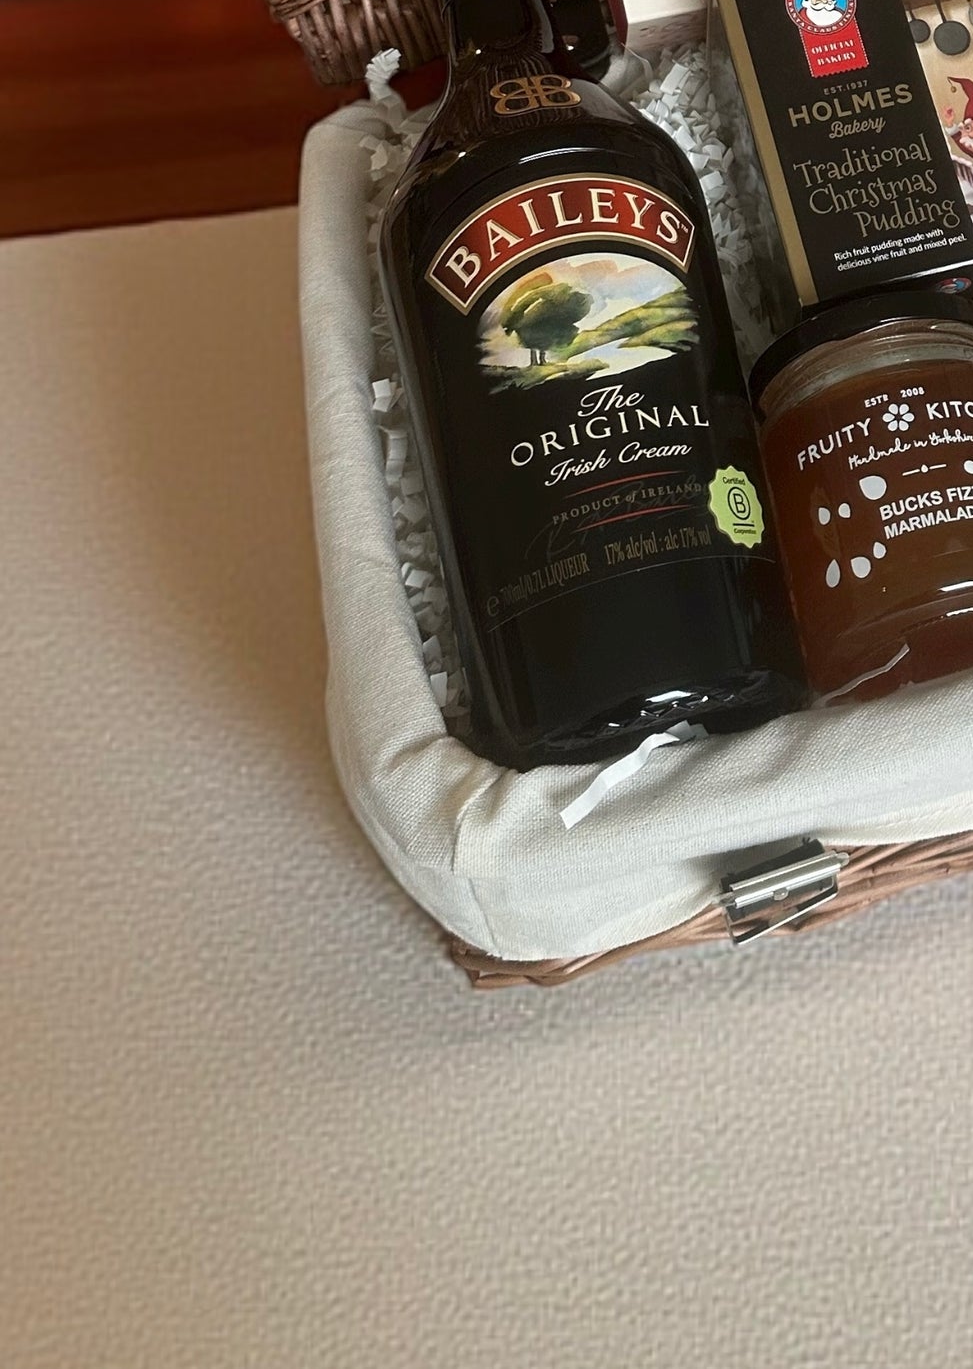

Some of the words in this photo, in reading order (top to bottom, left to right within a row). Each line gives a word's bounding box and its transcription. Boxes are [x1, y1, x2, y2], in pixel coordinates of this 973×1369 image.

[807, 25, 837, 33] CLAUS
[811, 39, 854, 54] OFFICIAL
[817, 51, 856, 66] BAKERY
[788, 83, 913, 128] HOLMES
[829, 117, 886, 139] Bakery
[793, 133, 932, 188] Traditional
[809, 168, 937, 214] Christmas
[853, 197, 961, 238] Pudding
[445, 188, 681, 288] BAILEYS
[834, 250, 852, 262] Rich
[853, 246, 871, 258] fruit
[871, 238, 903, 253] pudding
[903, 233, 925, 245] made
[925, 228, 944, 239] with
[837, 258, 872, 271] delicious
[872, 253, 889, 263] vine
[890, 248, 907, 259] fruit
[908, 244, 923, 254] and
[924, 239, 947, 250] mixed
[577, 384, 645, 417] The
[900, 386, 925, 398] 2008
[510, 405, 711, 467] ORIGINAL
[797, 417, 871, 471] FRUITY
[913, 439, 928, 448] in
[544, 449, 612, 487] Irish
[618, 441, 692, 464] Cream
[552, 495, 620, 526] PRODUCT
[624, 491, 638, 506] of
[640, 483, 702, 500] IRELAND
[733, 493, 746, 513] B
[879, 491, 943, 521] BUCKS
[544, 552, 590, 588] LIQUEUR
[604, 541, 626, 565] 17%
[626, 531, 658, 561] alc/vol
[665, 529, 679, 550] alc
[679, 527, 699, 549] 17%
[699, 525, 712, 546] vol
